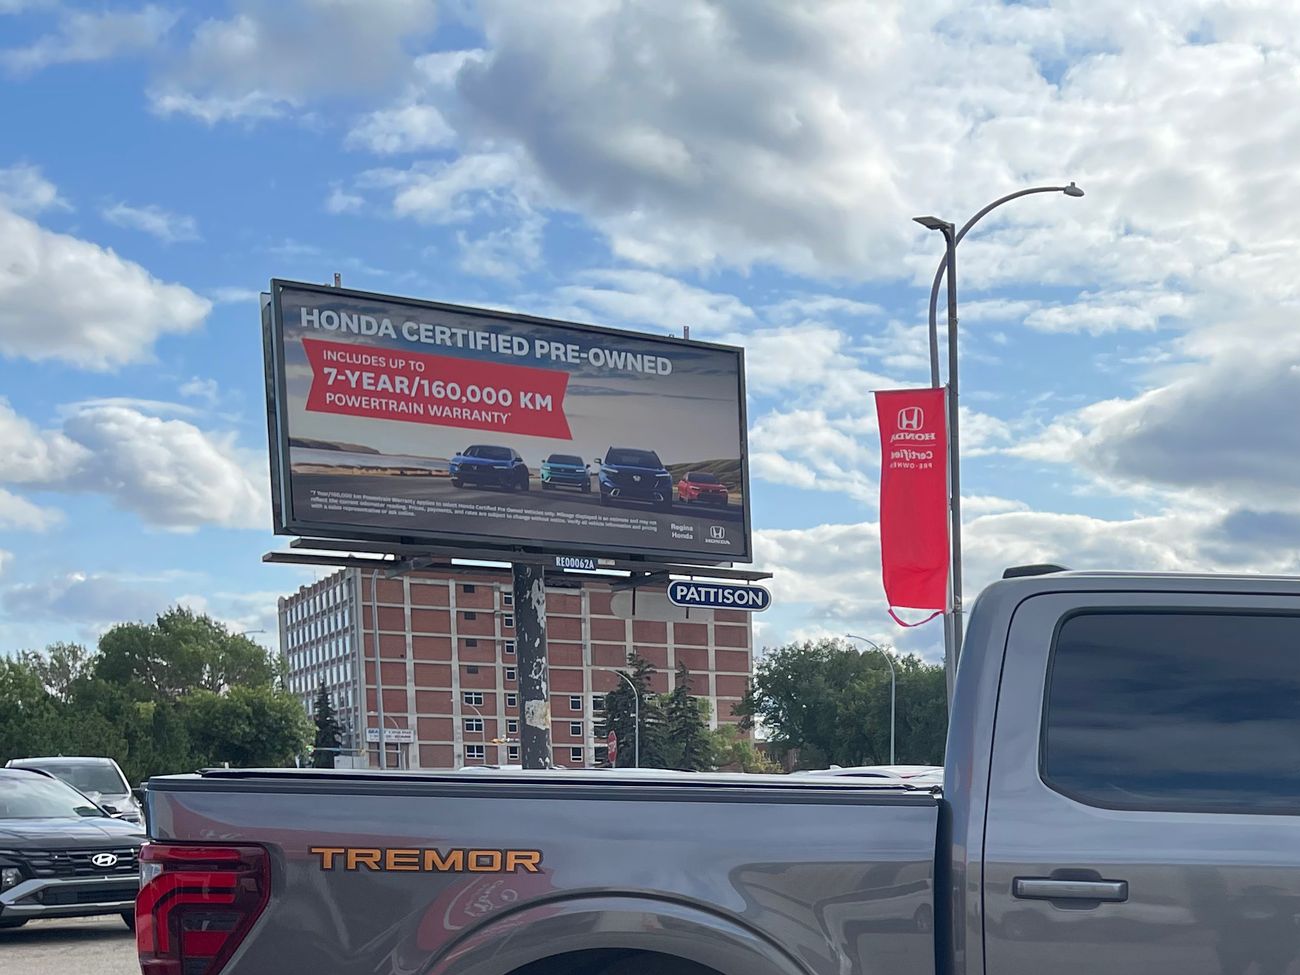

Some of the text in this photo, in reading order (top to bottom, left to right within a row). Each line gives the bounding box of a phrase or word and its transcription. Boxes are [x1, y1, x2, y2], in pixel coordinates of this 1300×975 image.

[300, 307, 673, 376] HONDA CERTIFIED PRE-OWNED
[323, 349, 425, 372] INCLUDES UP TO
[323, 367, 553, 412] 7-YEAR/160,000 KM
[326, 392, 424, 415] POWERTRAIN
[556, 556, 595, 569] RE00062A
[676, 585, 763, 606] PATTISON
[310, 847, 543, 873] TREMOR
